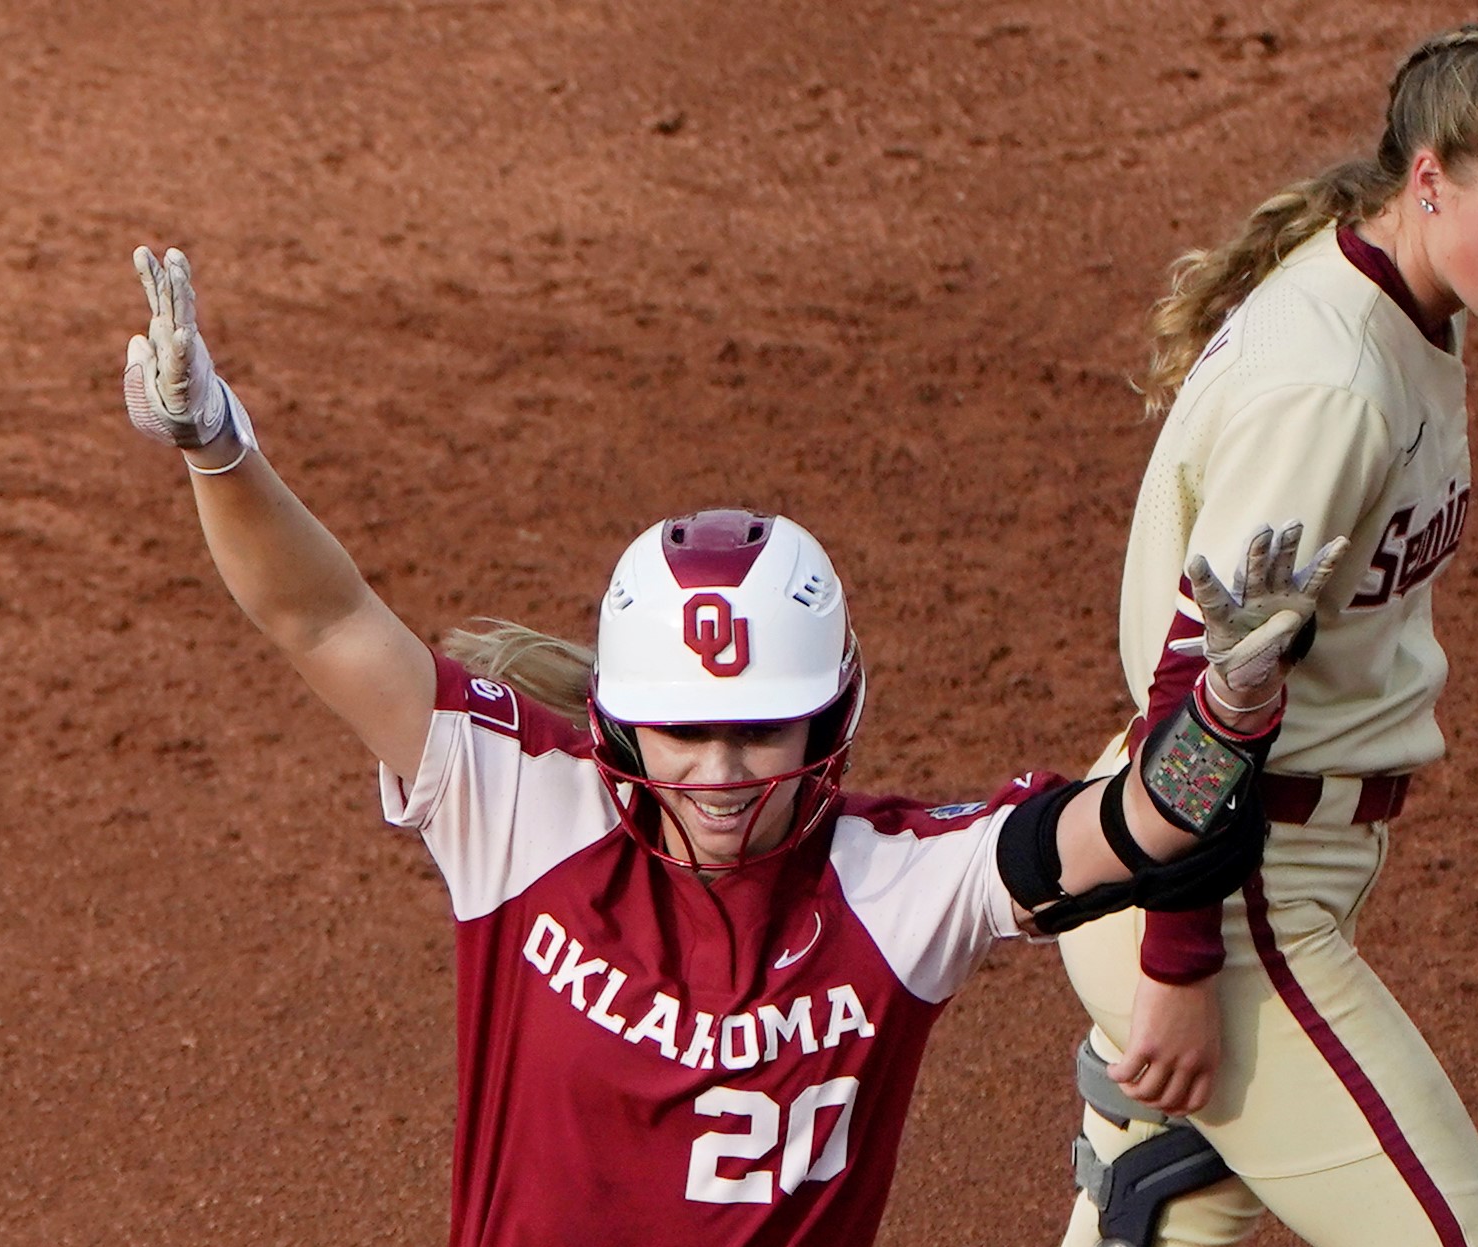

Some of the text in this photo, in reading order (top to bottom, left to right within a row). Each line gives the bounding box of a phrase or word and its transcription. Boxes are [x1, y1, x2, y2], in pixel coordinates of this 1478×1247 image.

[683, 593, 750, 677] OU
[522, 913, 876, 1070] OKLAHOMA
[685, 1076, 860, 1204] 20
